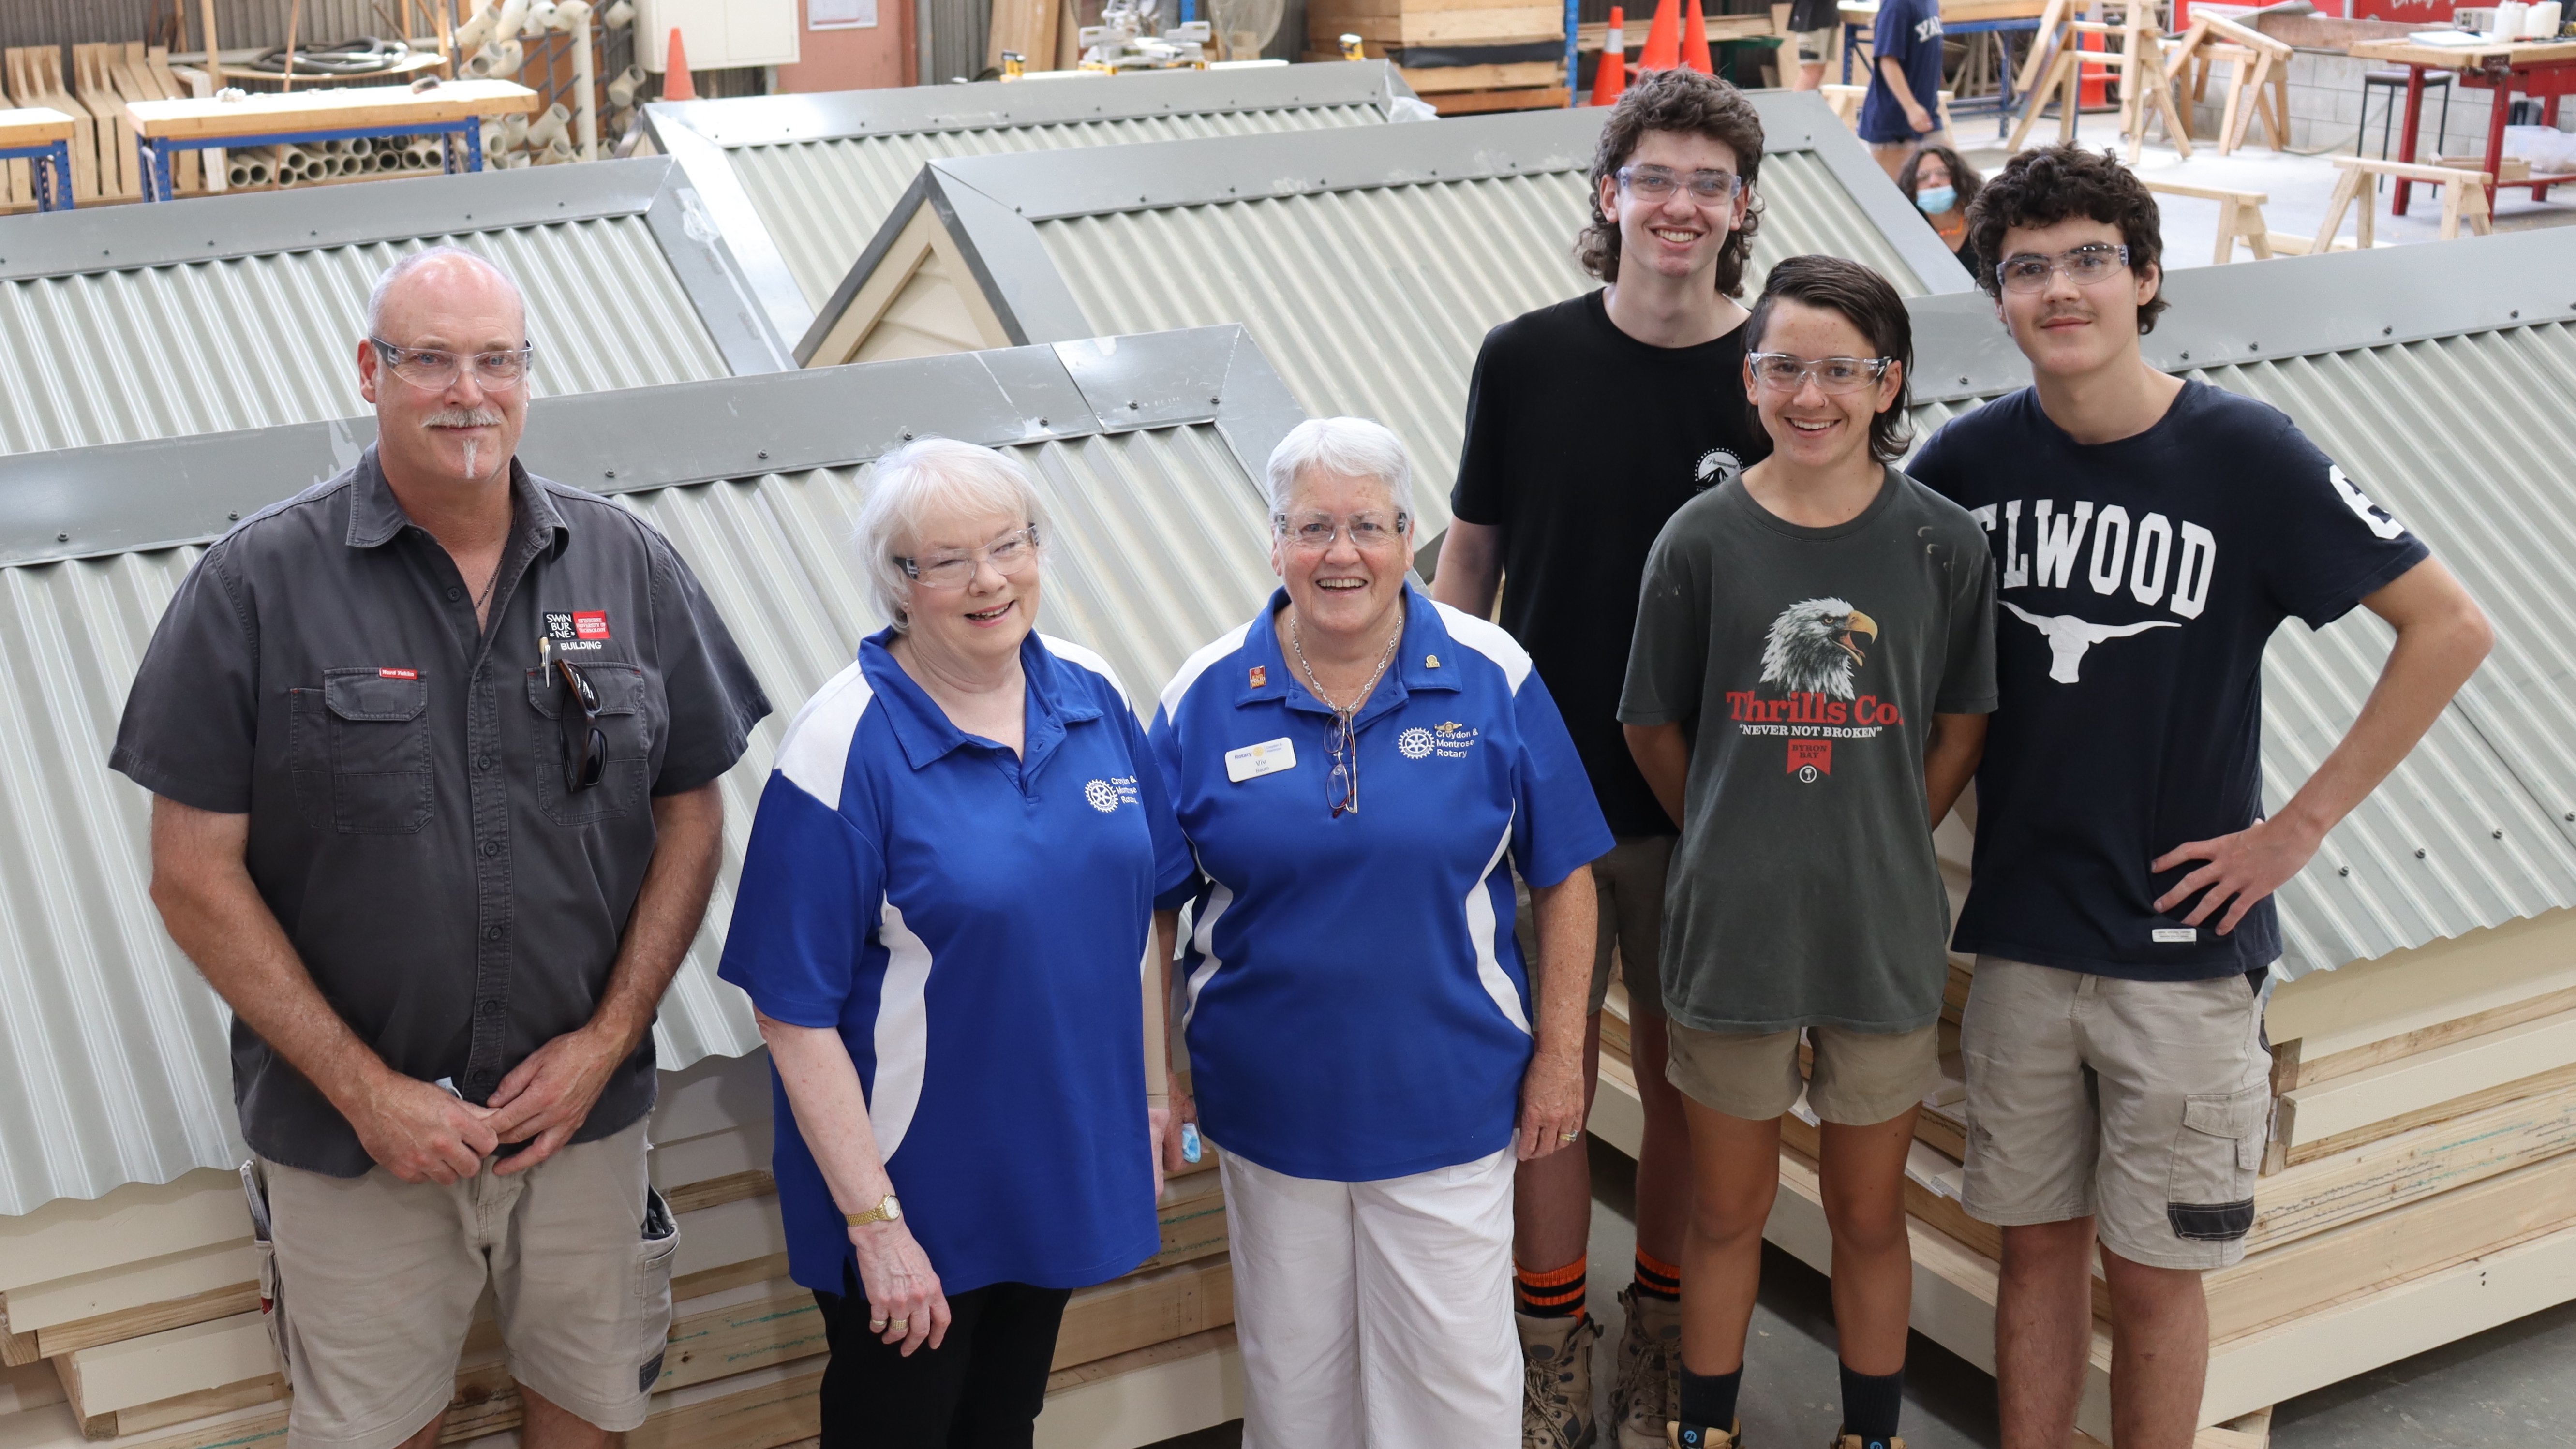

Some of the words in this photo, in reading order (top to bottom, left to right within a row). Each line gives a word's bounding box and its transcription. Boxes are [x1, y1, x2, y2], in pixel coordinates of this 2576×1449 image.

[1914, 16, 1944, 43] YAL
[551, 622, 572, 631] BUR
[560, 641, 602, 651] BUILDING
[1726, 690, 1848, 724] Thrills
[1854, 695, 1904, 726] Co.
[1436, 730, 1471, 740] Croydon
[1472, 728, 1479, 736] &
[1791, 726, 1820, 737] NOT
[1436, 739, 1474, 748] Montrose
[1235, 752, 1252, 760] Rotary
[1436, 748, 1468, 758] Rotary
[1111, 776, 1131, 785] Croyon
[1129, 775, 1137, 783] &
[1120, 795, 1139, 805] Rotay
